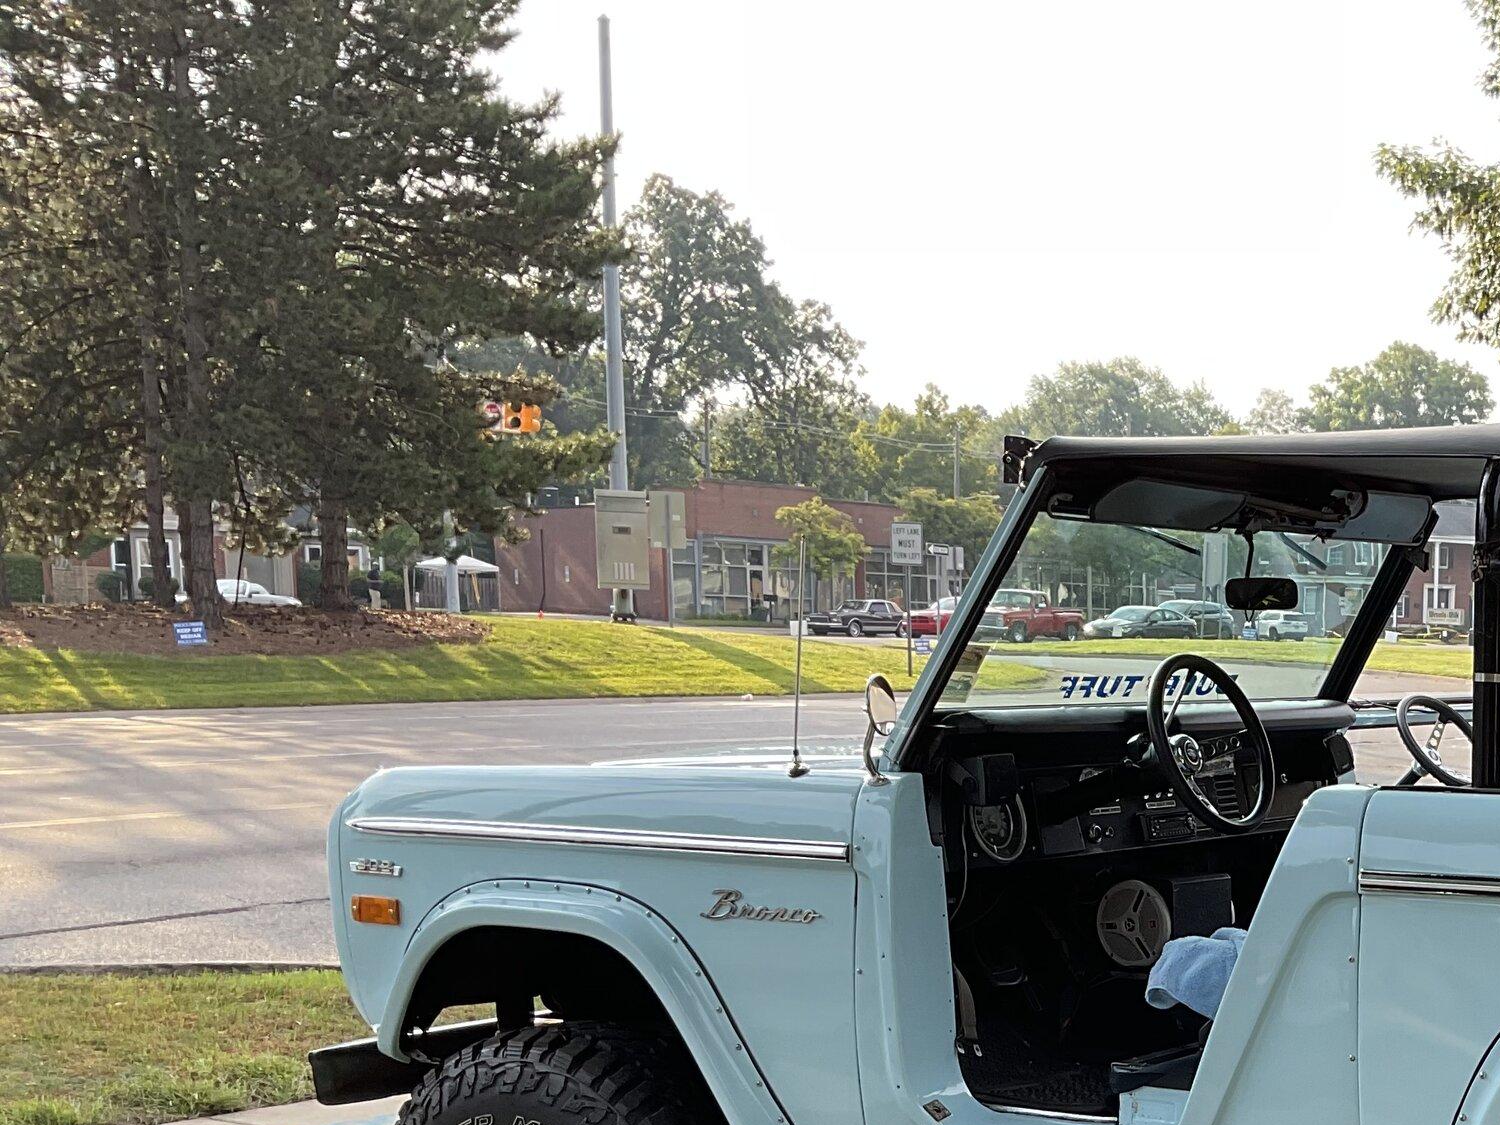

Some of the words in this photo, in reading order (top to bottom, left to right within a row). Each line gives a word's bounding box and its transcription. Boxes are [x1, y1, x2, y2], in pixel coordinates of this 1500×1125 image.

[893, 527, 905, 535] LEFT
[906, 527, 920, 535] LANE
[898, 539, 915, 548] MUST
[700, 888, 823, 924] Bronco
